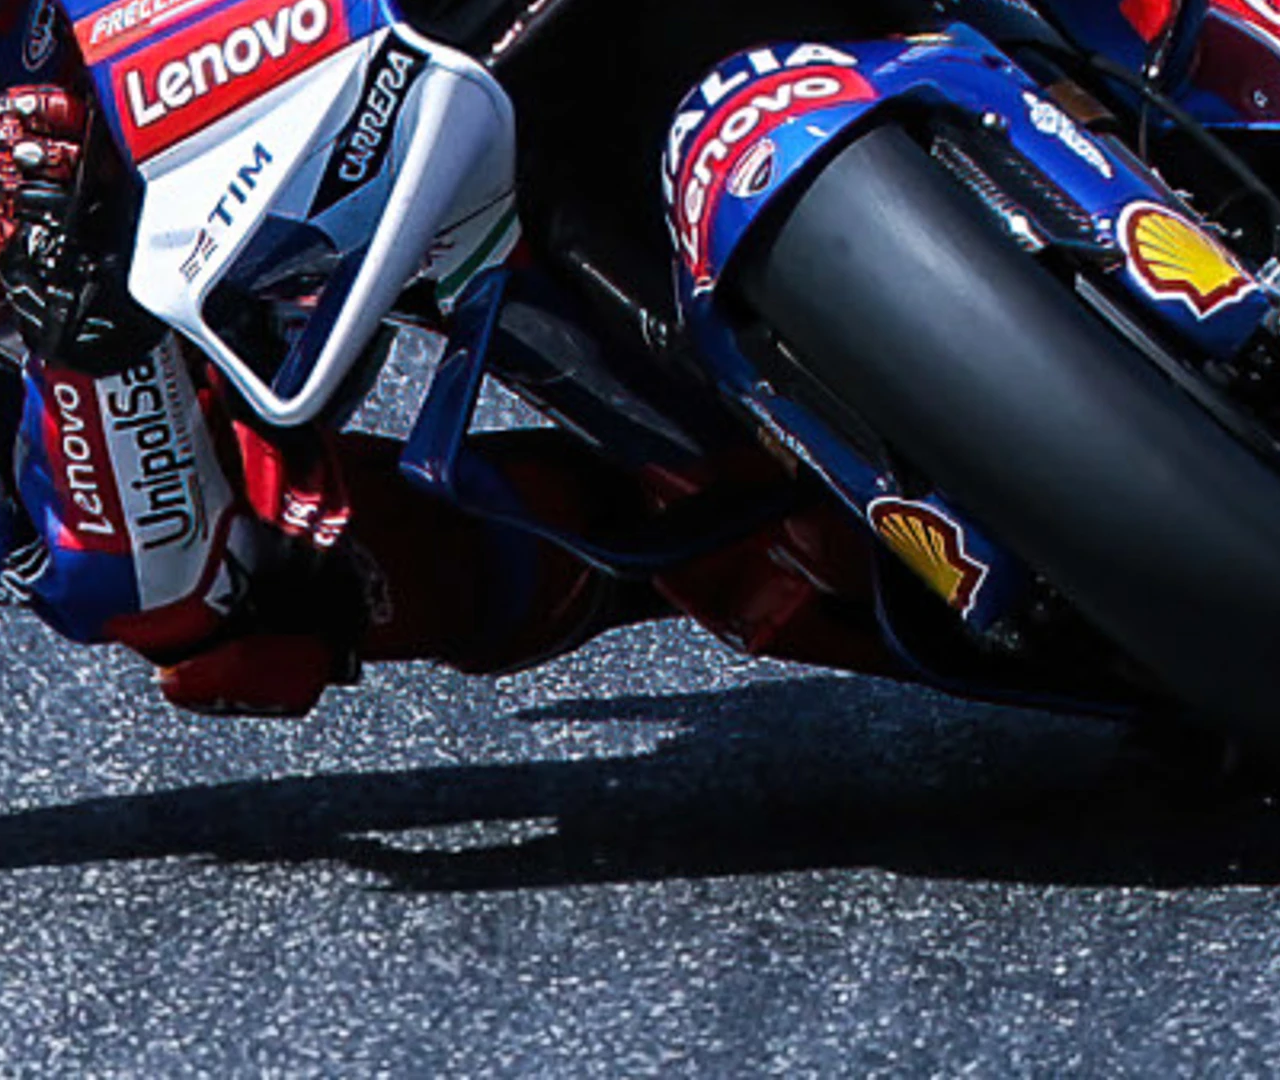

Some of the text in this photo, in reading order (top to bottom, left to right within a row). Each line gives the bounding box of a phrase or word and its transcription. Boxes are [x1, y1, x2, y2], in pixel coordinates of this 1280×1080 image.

[207, 141, 272, 227] TIM
[338, 49, 415, 183] CARRERA
[663, 43, 858, 205] ALIA
[681, 76, 842, 265] Lenovo
[53, 382, 116, 536] Lenovo
[107, 364, 196, 551] UnipolSa
